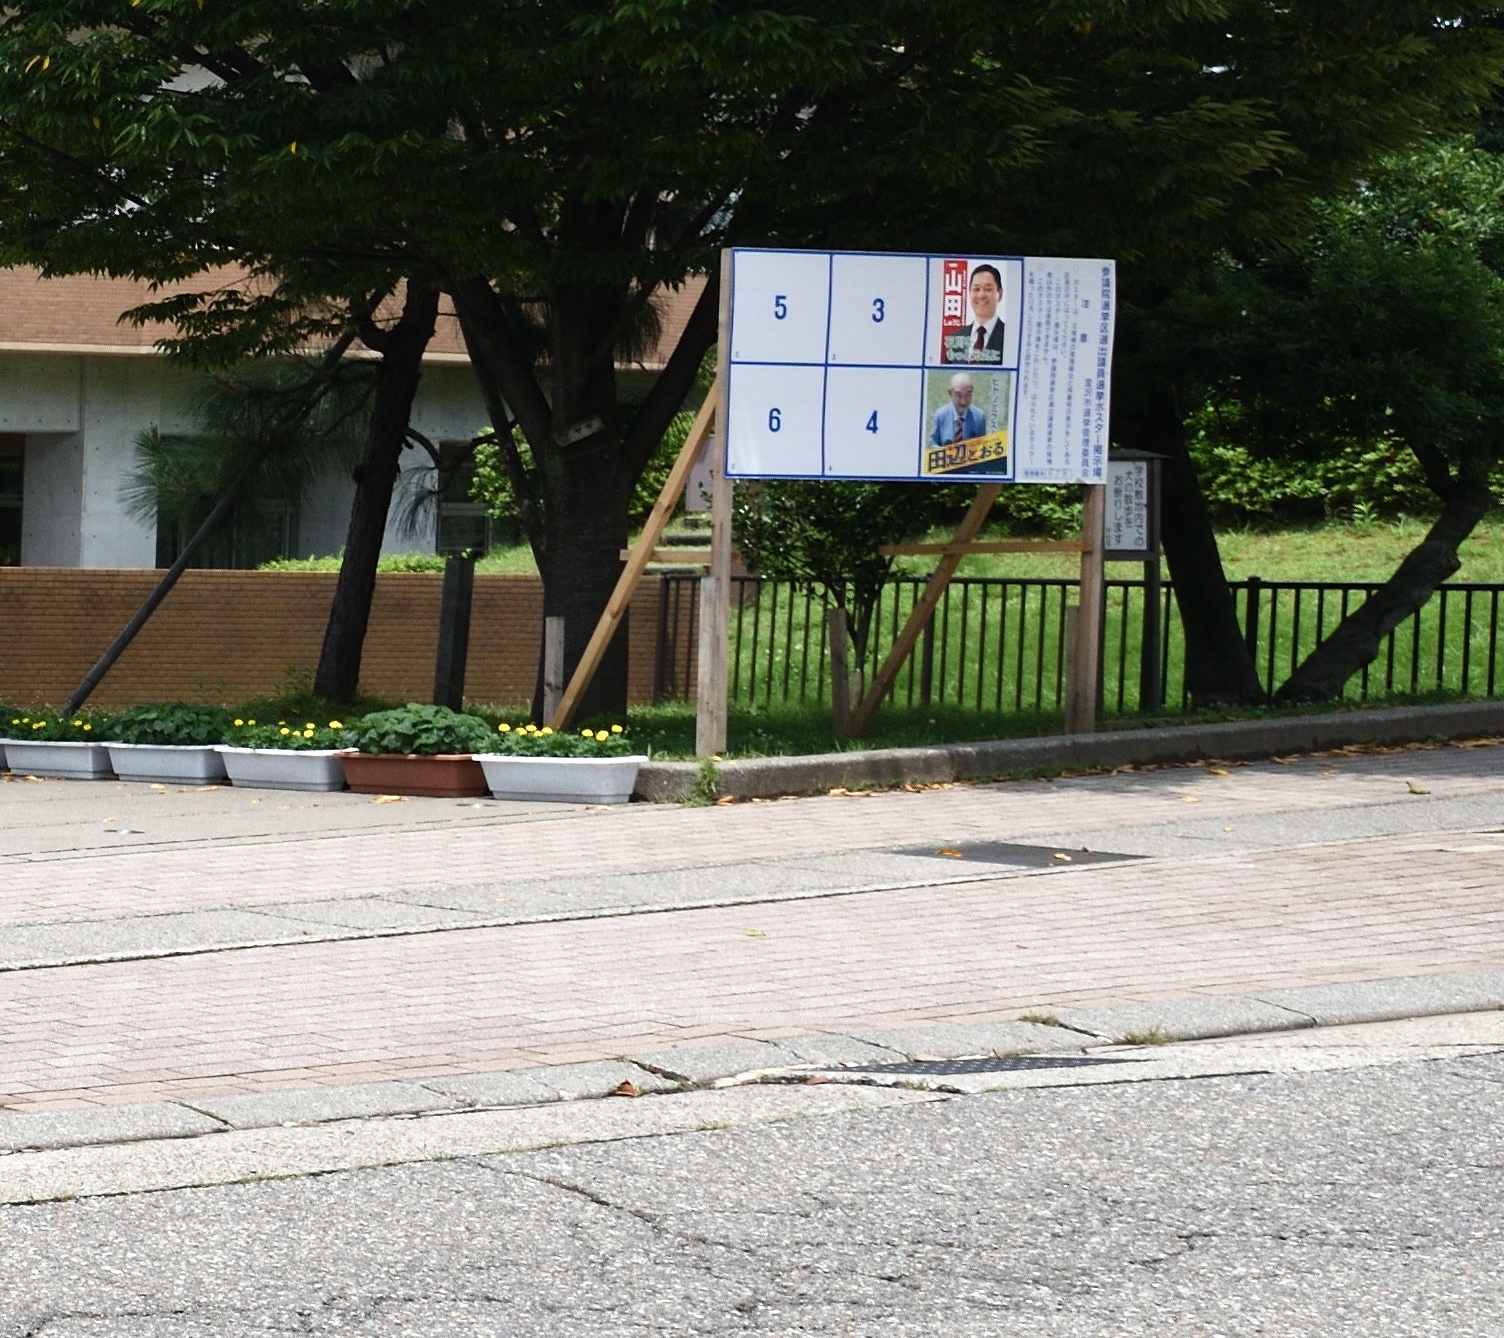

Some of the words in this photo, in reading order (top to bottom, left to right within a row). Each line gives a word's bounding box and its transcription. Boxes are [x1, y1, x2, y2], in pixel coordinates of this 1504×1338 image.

[944, 269, 962, 317] 山田
[774, 295, 787, 320] 5
[871, 298, 885, 323] 3
[768, 407, 782, 432] 6
[865, 410, 878, 434] 4
